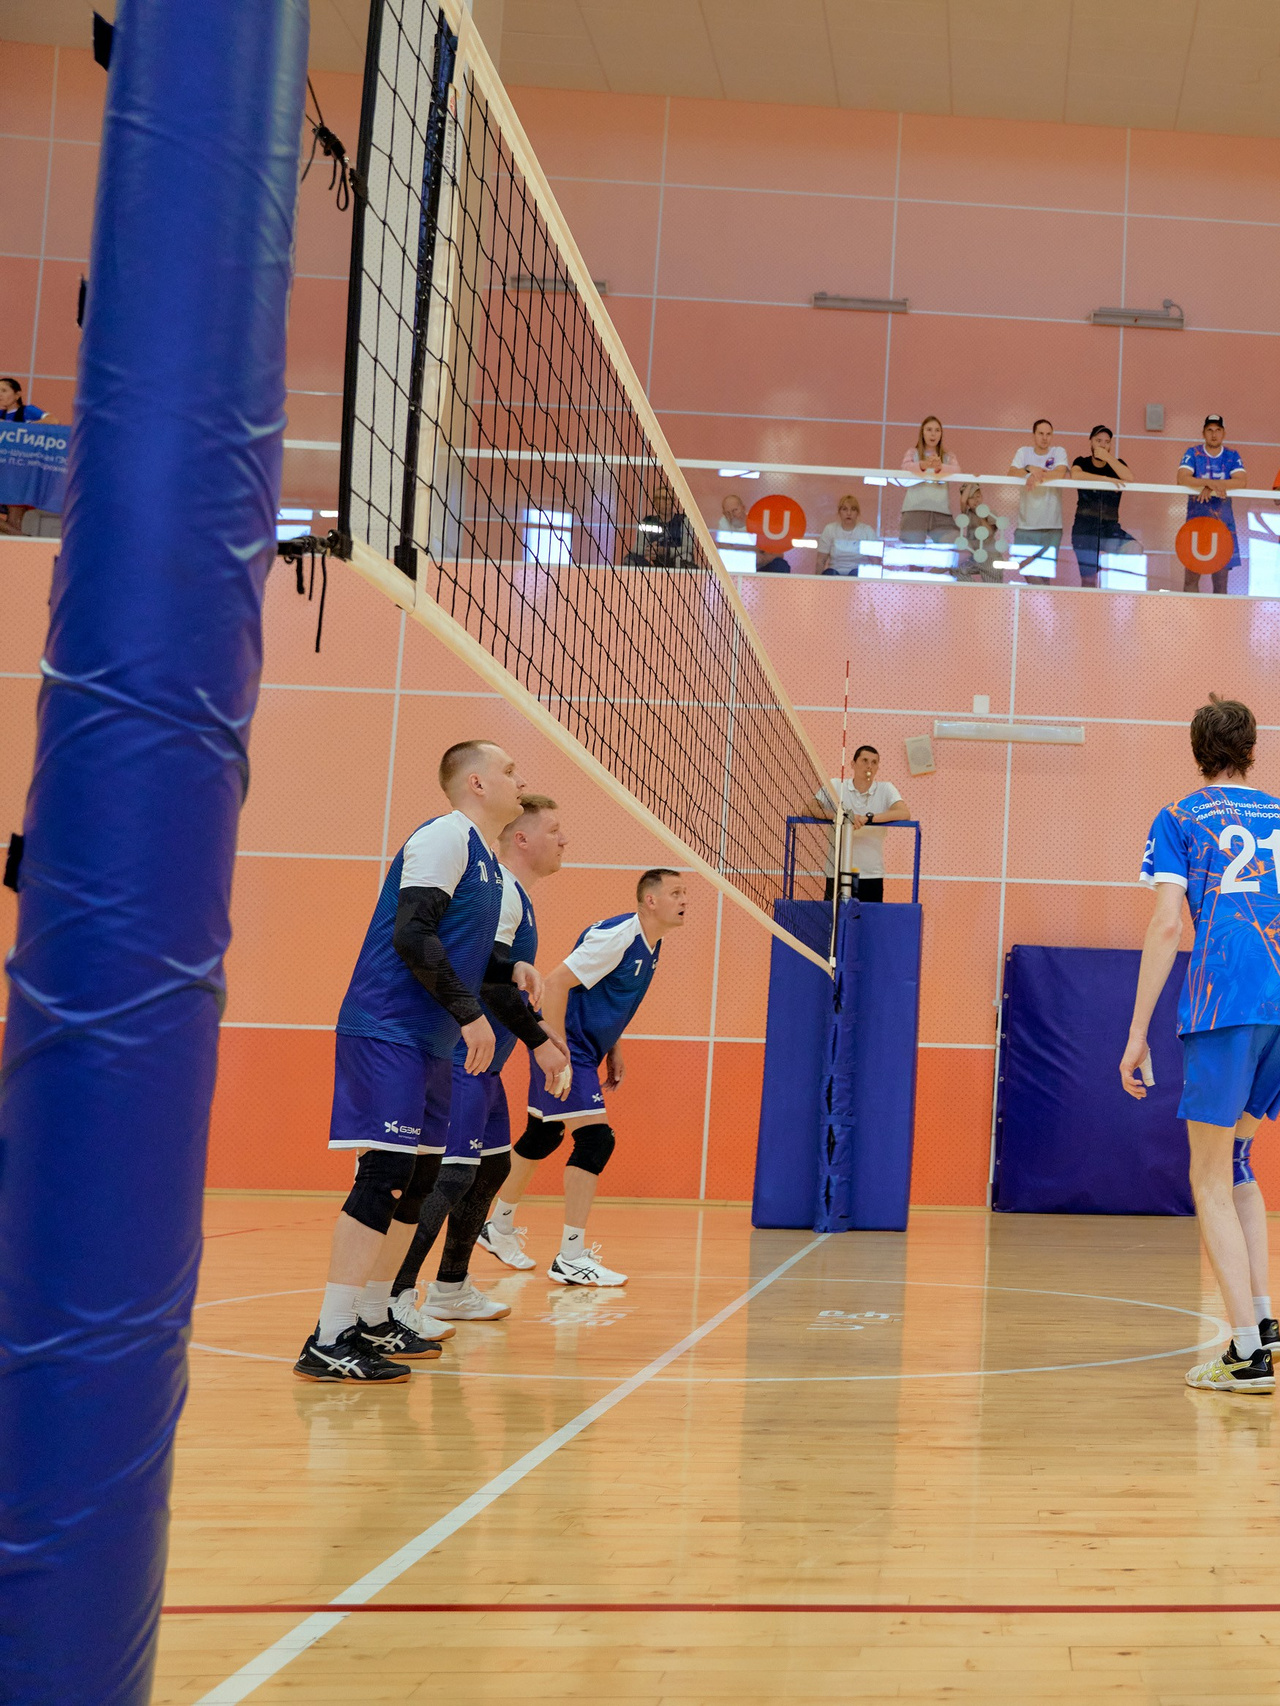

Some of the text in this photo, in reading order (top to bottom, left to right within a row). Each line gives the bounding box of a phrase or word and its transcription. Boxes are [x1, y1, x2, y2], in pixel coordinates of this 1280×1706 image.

[762, 509, 791, 540] U
[1191, 531, 1218, 561] U
[634, 959, 643, 977] 7
